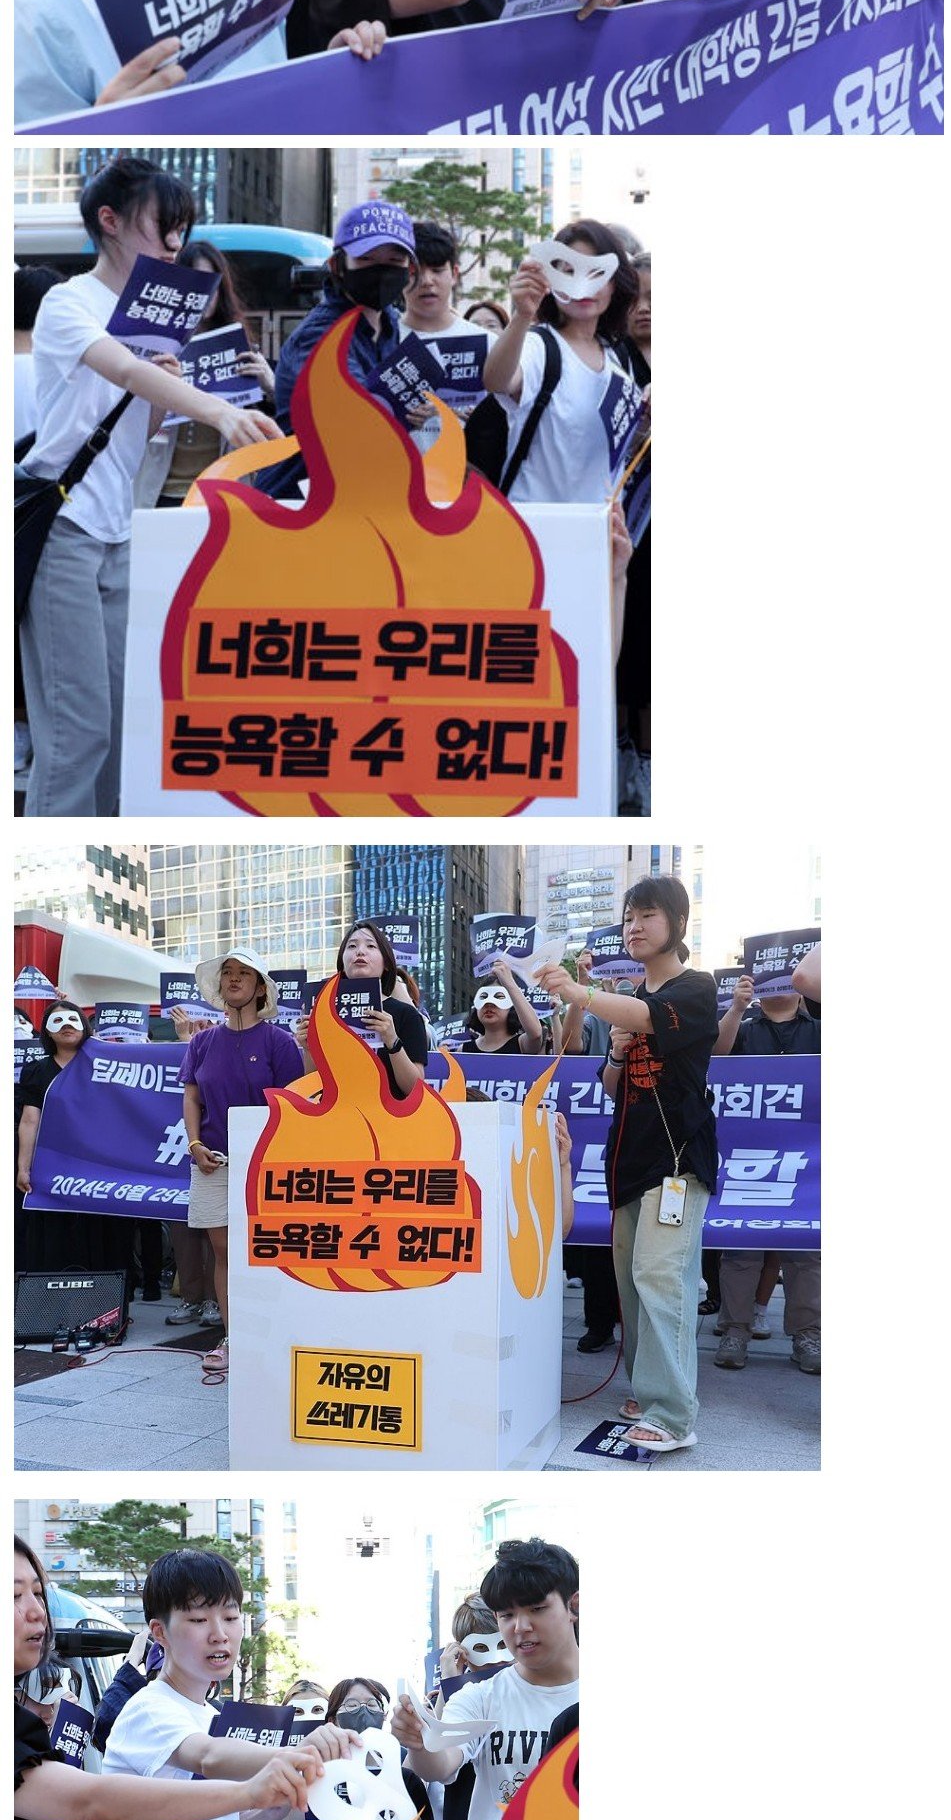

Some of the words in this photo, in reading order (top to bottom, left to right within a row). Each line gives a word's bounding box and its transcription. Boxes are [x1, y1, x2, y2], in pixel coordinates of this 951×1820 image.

[361, 206, 404, 222] POWER
[196, 617, 362, 682] 너희는
[375, 619, 541, 685] 우리를
[169, 713, 338, 779] 능욕할
[349, 717, 406, 780] 수
[435, 717, 568, 782] 없다!
[340, 992, 371, 1007] 우리를
[50, 1175, 114, 1197] 2024년
[114, 1184, 152, 1201] 8월
[264, 1167, 356, 1204] 너희는
[362, 1168, 458, 1205] 우리를
[252, 1223, 343, 1260] 능욕할
[350, 1224, 381, 1259] 수
[397, 1225, 475, 1263] 없다!
[47, 1280, 95, 1289] CUBE
[317, 1361, 391, 1392] 자유의
[306, 1400, 402, 1434] 쓰레기통
